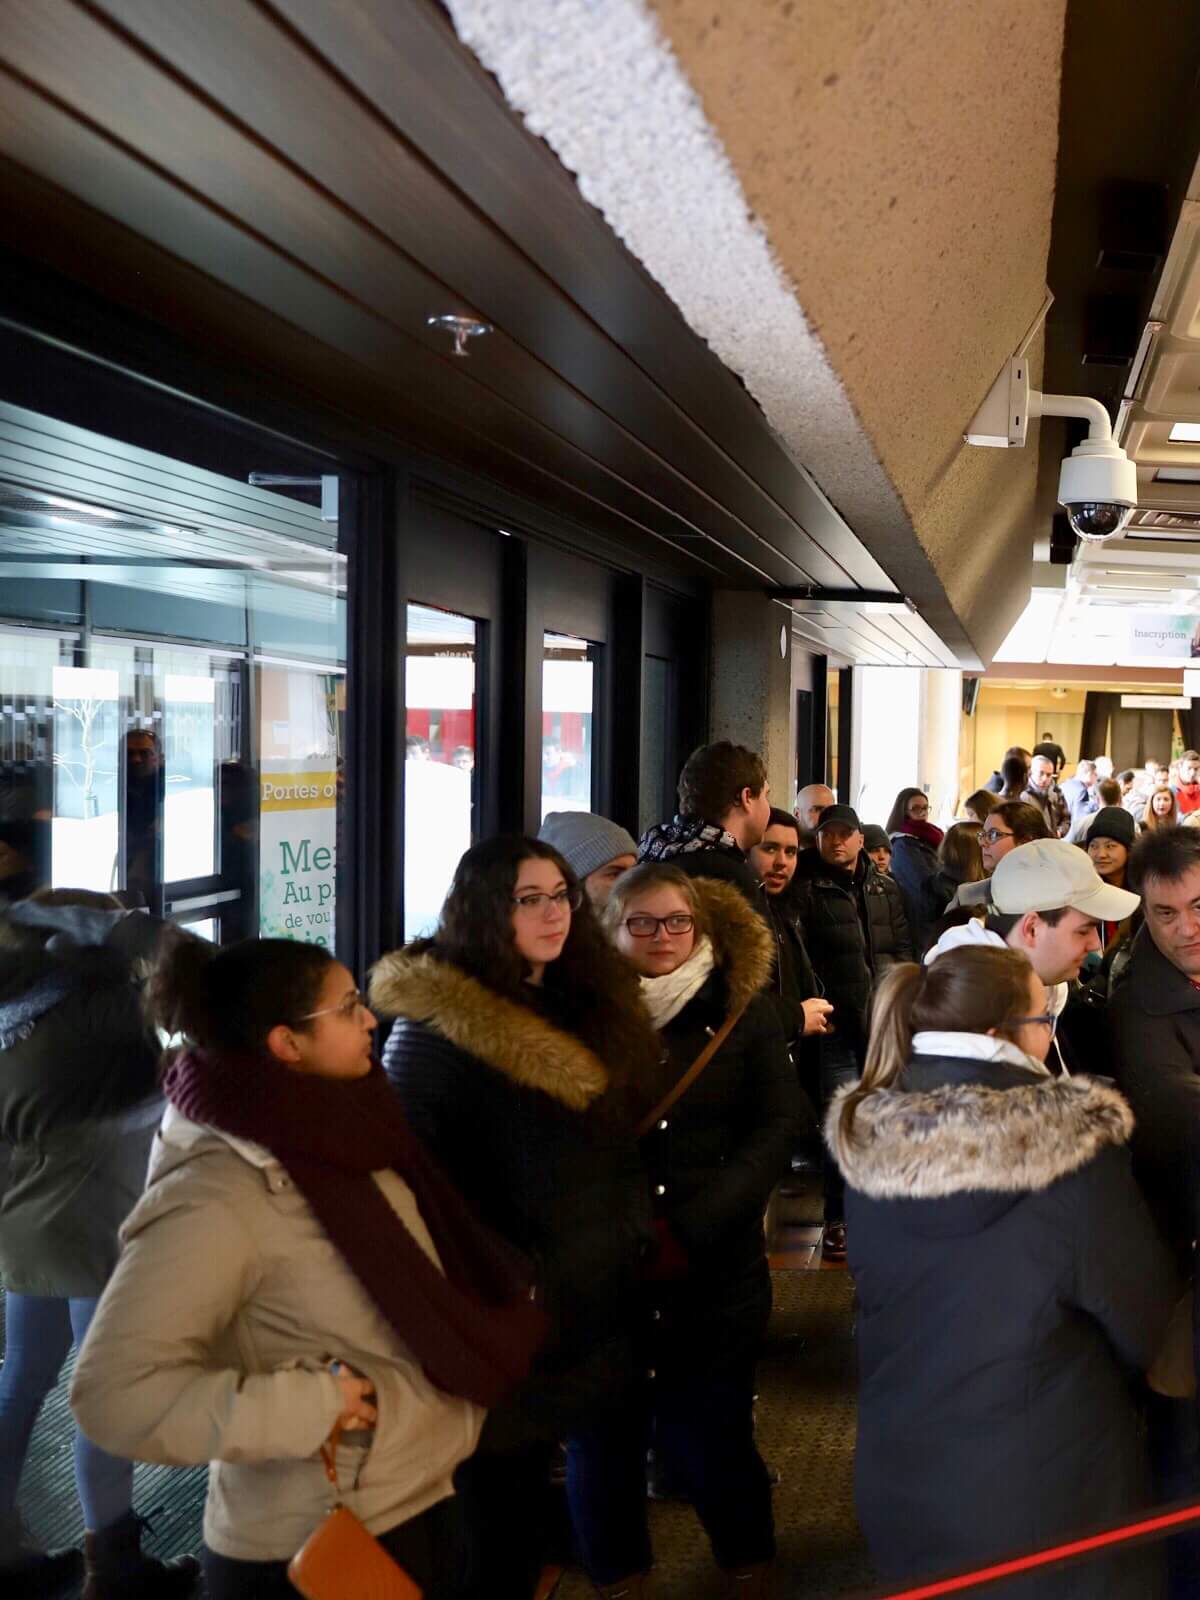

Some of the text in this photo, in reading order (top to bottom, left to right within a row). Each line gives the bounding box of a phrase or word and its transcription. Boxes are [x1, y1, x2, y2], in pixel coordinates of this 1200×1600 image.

[1134, 628, 1187, 641] Inscription
[262, 783, 319, 801] Portes
[279, 840, 337, 875] Me
[282, 881, 312, 905] Au
[284, 914, 303, 929] de
